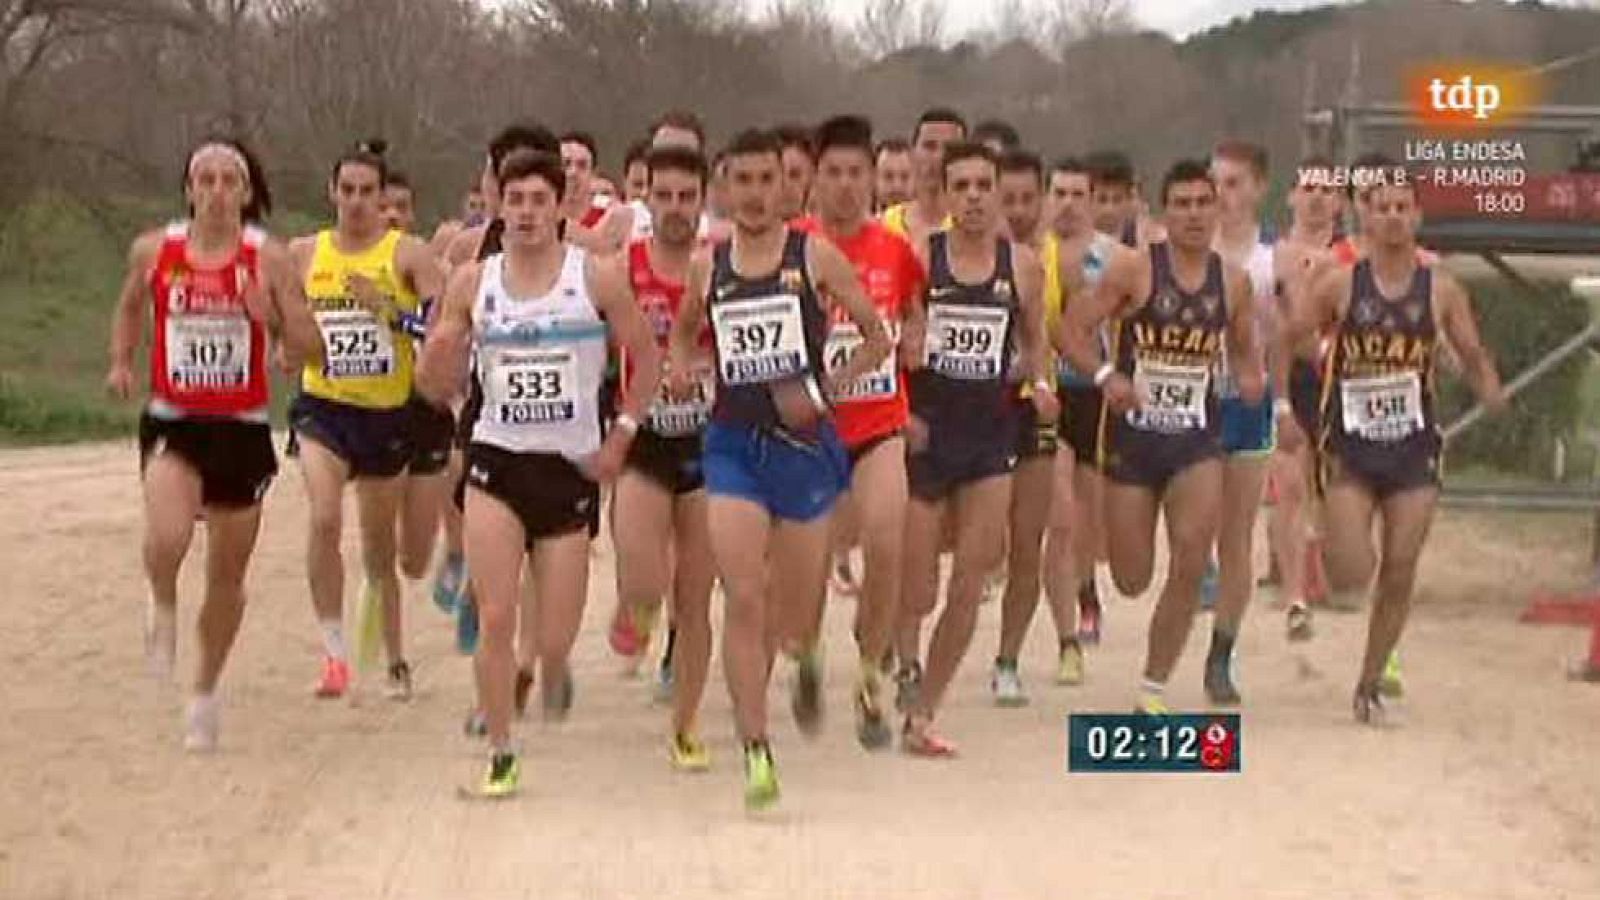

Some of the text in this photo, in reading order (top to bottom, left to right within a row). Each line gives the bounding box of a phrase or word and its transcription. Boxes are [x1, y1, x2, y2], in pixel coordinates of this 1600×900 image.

[329, 328, 379, 356] 525
[730, 321, 784, 354] 397
[941, 325, 992, 354] 399
[508, 371, 562, 399] 533
